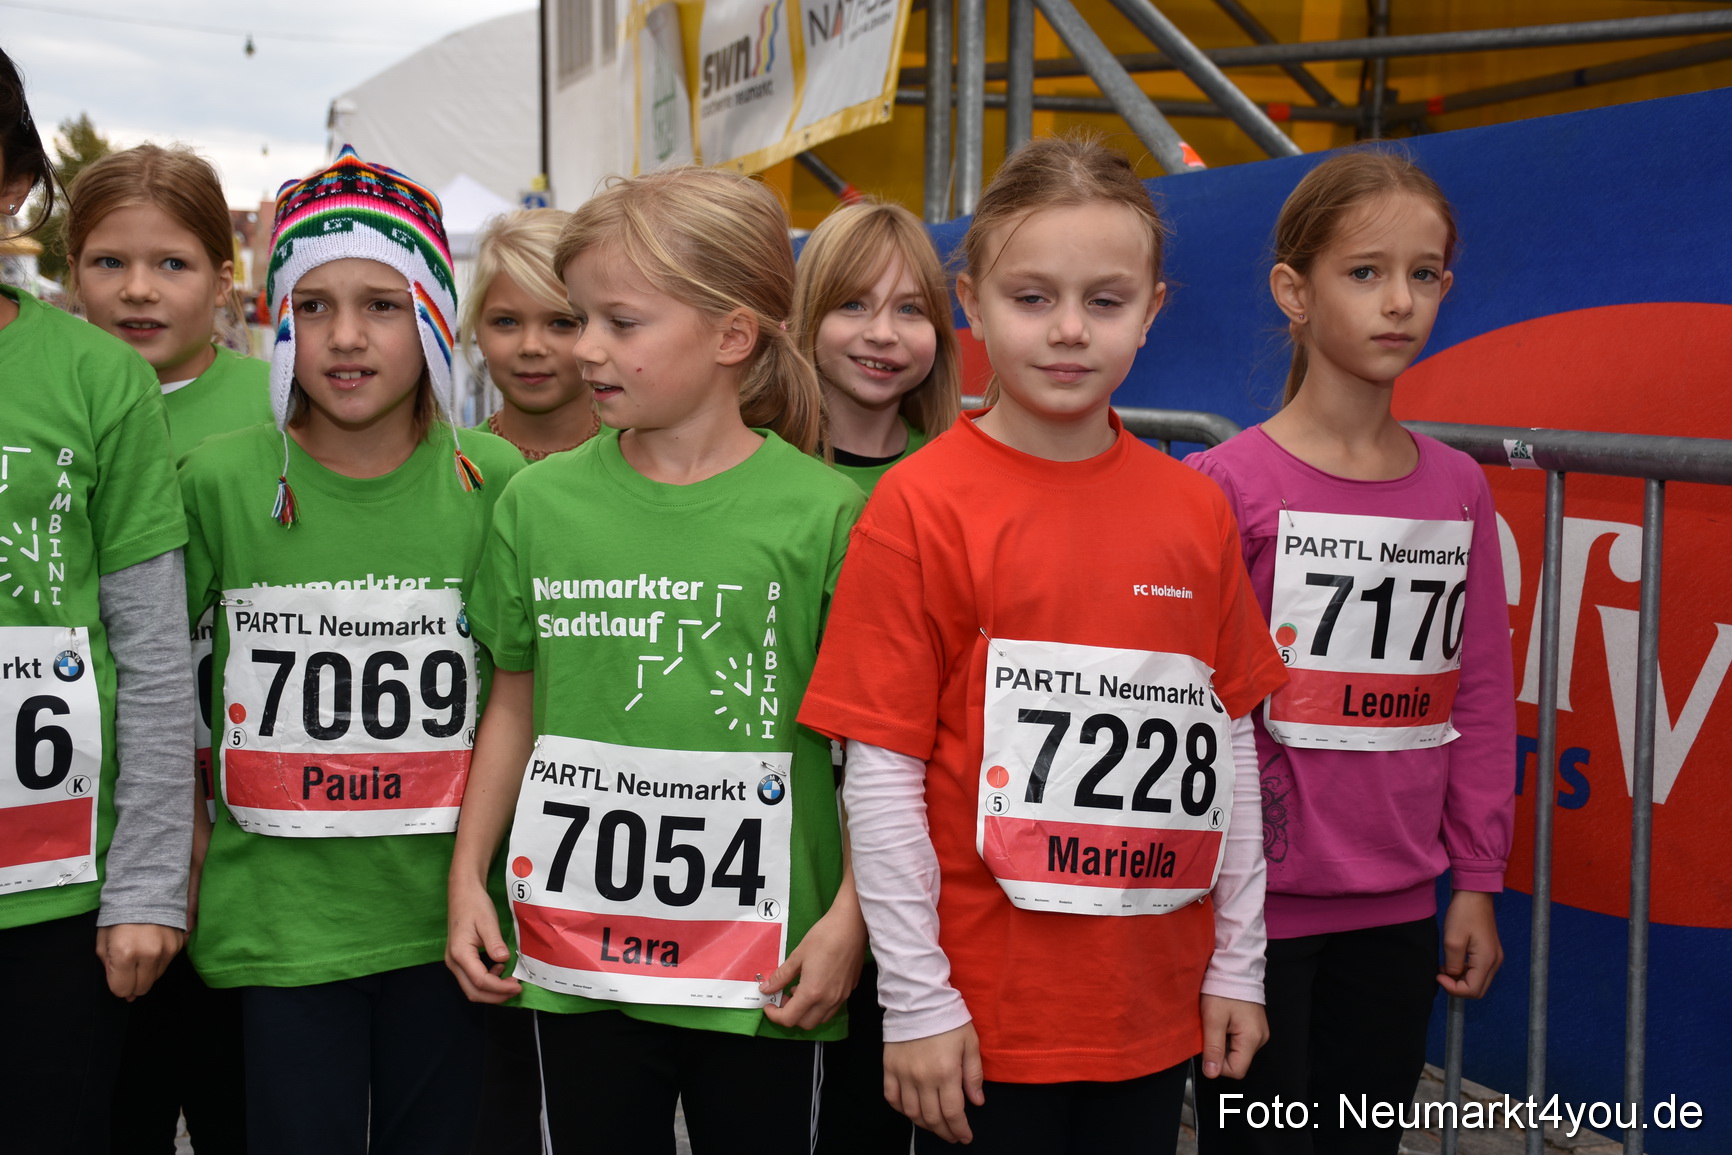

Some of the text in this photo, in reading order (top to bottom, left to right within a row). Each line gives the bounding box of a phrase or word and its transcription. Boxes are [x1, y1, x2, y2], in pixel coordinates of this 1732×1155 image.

[49, 448, 73, 605] BAMBINI
[1286, 536, 1372, 561] PARTL
[533, 574, 703, 601] Neumarkter
[1133, 584, 1193, 599] FC Holzheim
[235, 611, 311, 635] PARTL
[319, 614, 446, 637] Neumarkt
[538, 611, 665, 643] Sadtlauf
[1306, 572, 1466, 661] 7170
[0, 656, 42, 679] rkt
[760, 582, 780, 738] BAMBINI
[1281, 649, 1290, 664] 5
[252, 649, 467, 740] 7069
[995, 666, 1204, 707] PARTL Neumarkt
[1343, 685, 1430, 718] Leonie
[233, 730, 241, 746] 5
[1018, 708, 1217, 816] 7228
[73, 776, 84, 793] K
[303, 766, 401, 801] Paula
[530, 760, 608, 792] PARTL
[616, 772, 746, 801] Neumarkt
[993, 796, 1002, 813] 5
[1212, 810, 1219, 826] K
[543, 801, 766, 907] 7054
[1048, 835, 1176, 879] Mariella
[517, 883, 525, 899] 5
[764, 901, 774, 917] K
[600, 927, 680, 967] Lara
